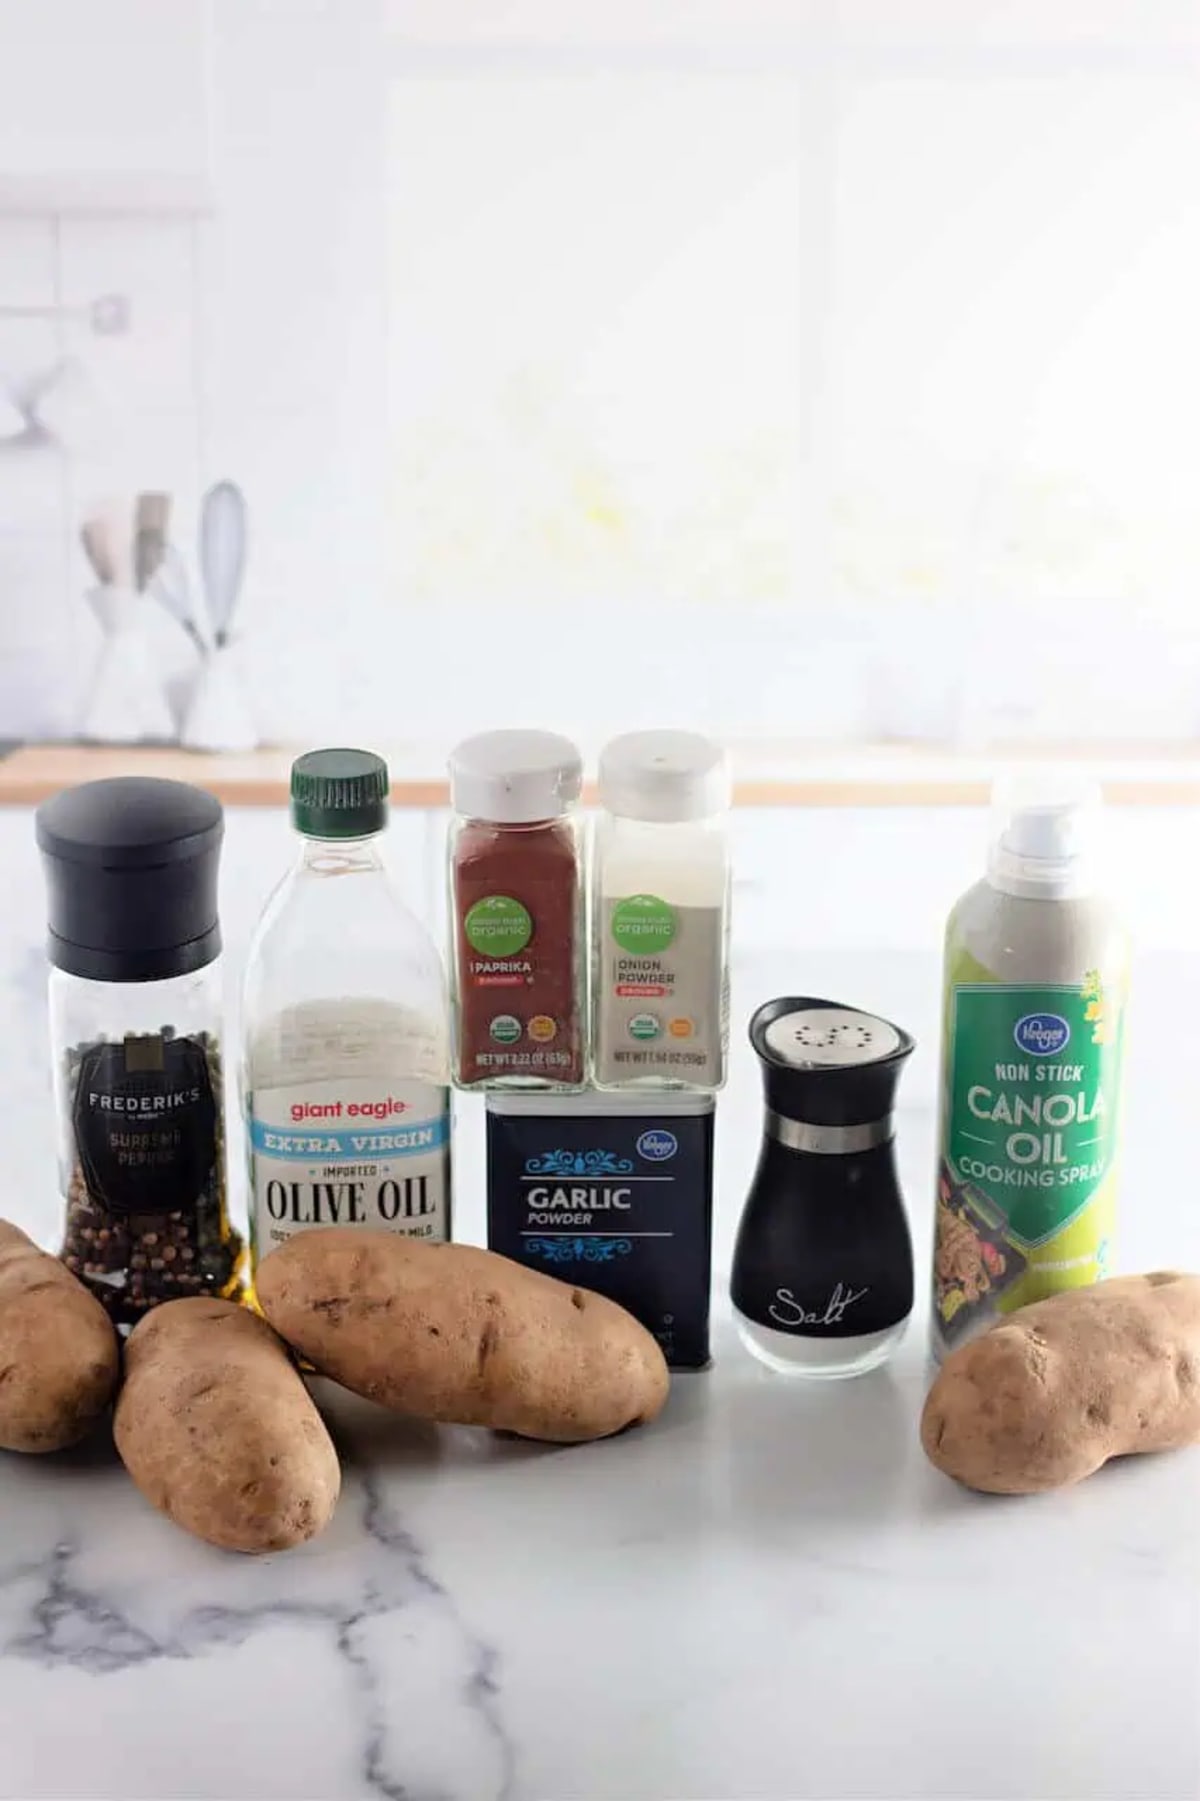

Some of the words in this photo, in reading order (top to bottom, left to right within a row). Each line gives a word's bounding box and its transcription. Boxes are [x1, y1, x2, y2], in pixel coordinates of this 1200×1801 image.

[615, 924, 671, 936] organic
[475, 961, 532, 974] PAPRIKA
[618, 959, 661, 970] ONION
[618, 972, 675, 984] POWDER
[1023, 1020, 1064, 1049] Kroger
[995, 1063, 1030, 1082] NON
[1035, 1063, 1085, 1082] STICK
[89, 1087, 201, 1112] FREDERIK'S
[291, 1101, 344, 1122] giant
[347, 1097, 406, 1119] eagle
[967, 1085, 1107, 1127] CANOLA
[263, 1131, 343, 1152] EXTRA
[351, 1128, 434, 1151] VIRGIN
[1005, 1132, 1068, 1165] OIL
[322, 1164, 379, 1178] IMPORTED
[959, 1155, 1055, 1188] COOKING
[266, 1179, 366, 1224] OLIVE
[377, 1175, 436, 1221] OIL
[527, 1187, 632, 1210] GARLIC
[527, 1212, 593, 1226] POWDER
[769, 1281, 868, 1326] Salt
